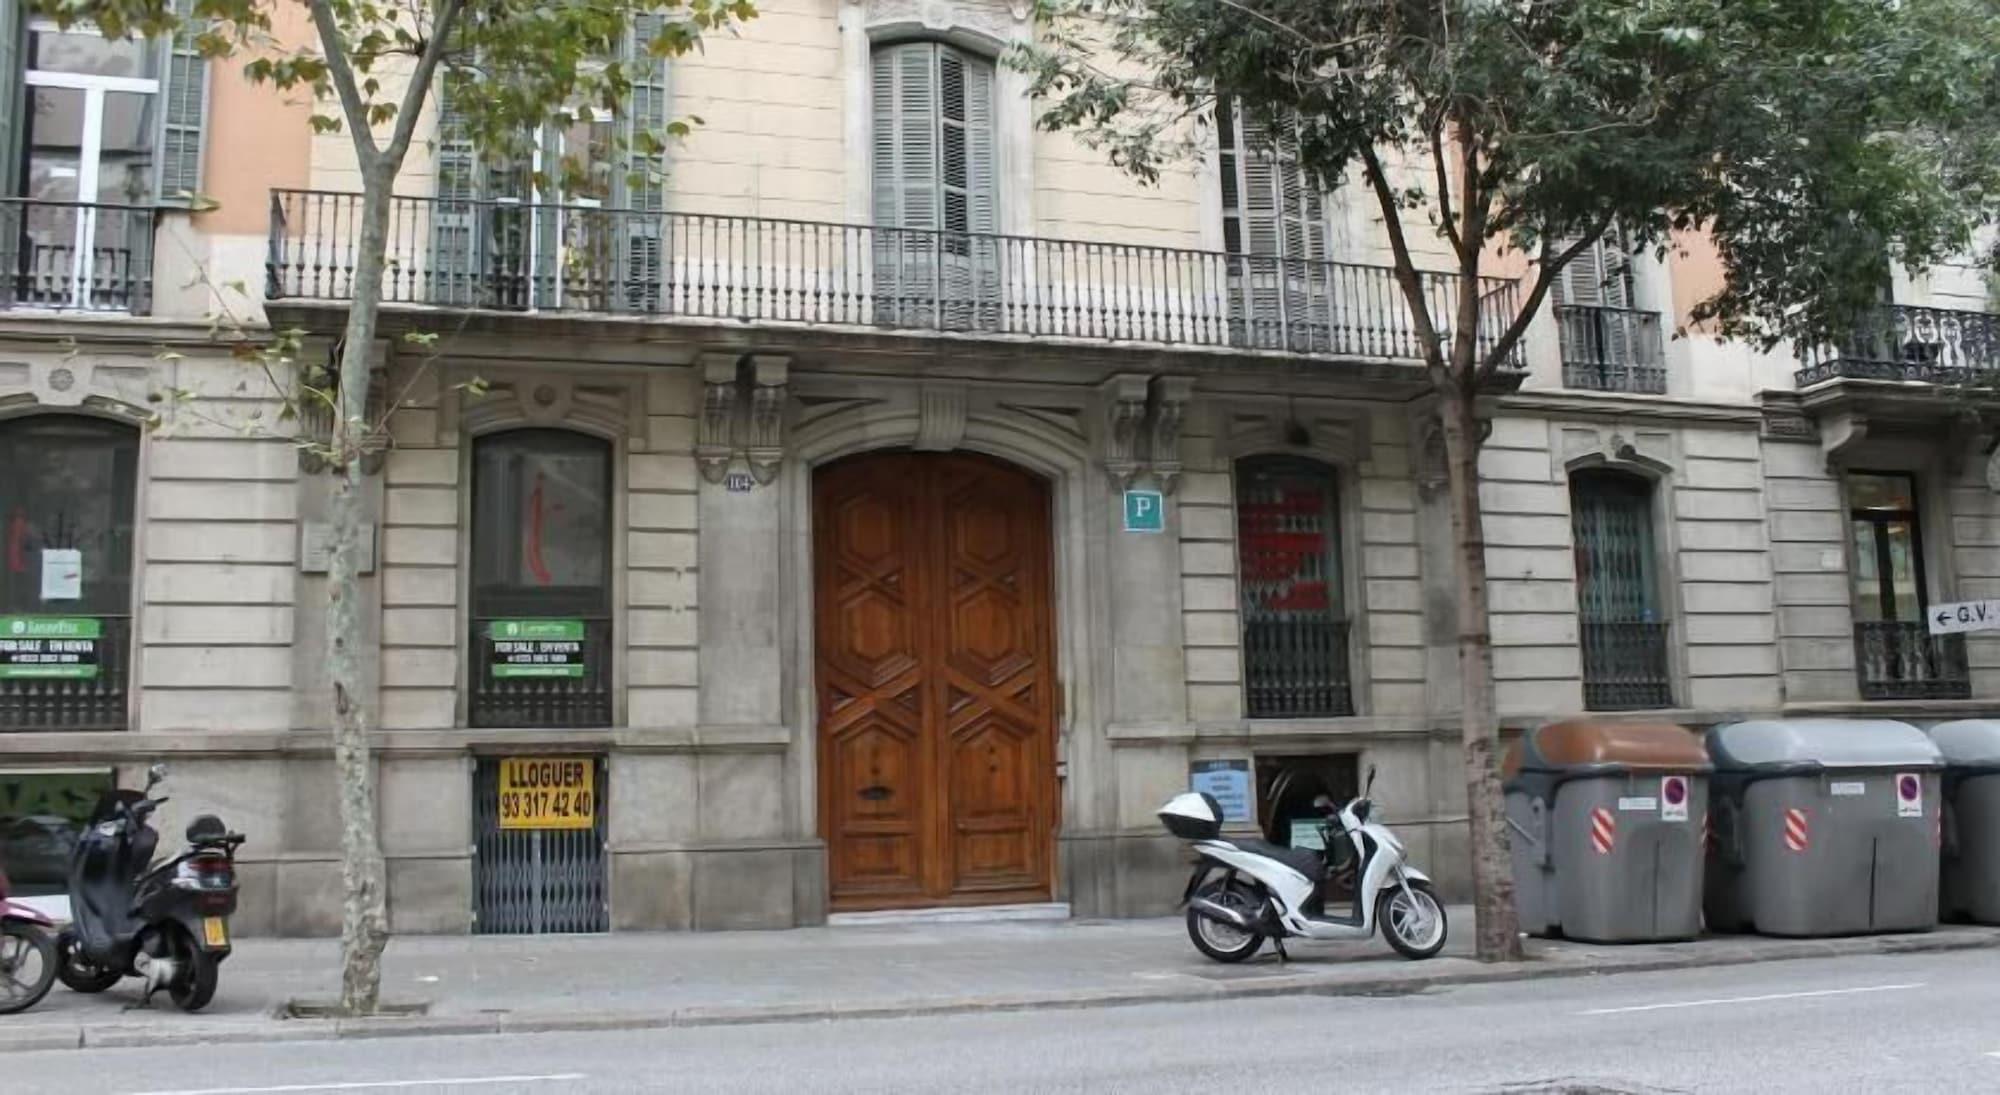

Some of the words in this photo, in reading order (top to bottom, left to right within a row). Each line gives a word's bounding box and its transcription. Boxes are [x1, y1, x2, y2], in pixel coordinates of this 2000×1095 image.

[1136, 496, 1150, 518] P
[509, 761, 584, 788] LLOGUER
[502, 792, 519, 818] 93
[523, 791, 548, 818] 317
[553, 791, 570, 817] 42
[574, 790, 592, 817] 40
